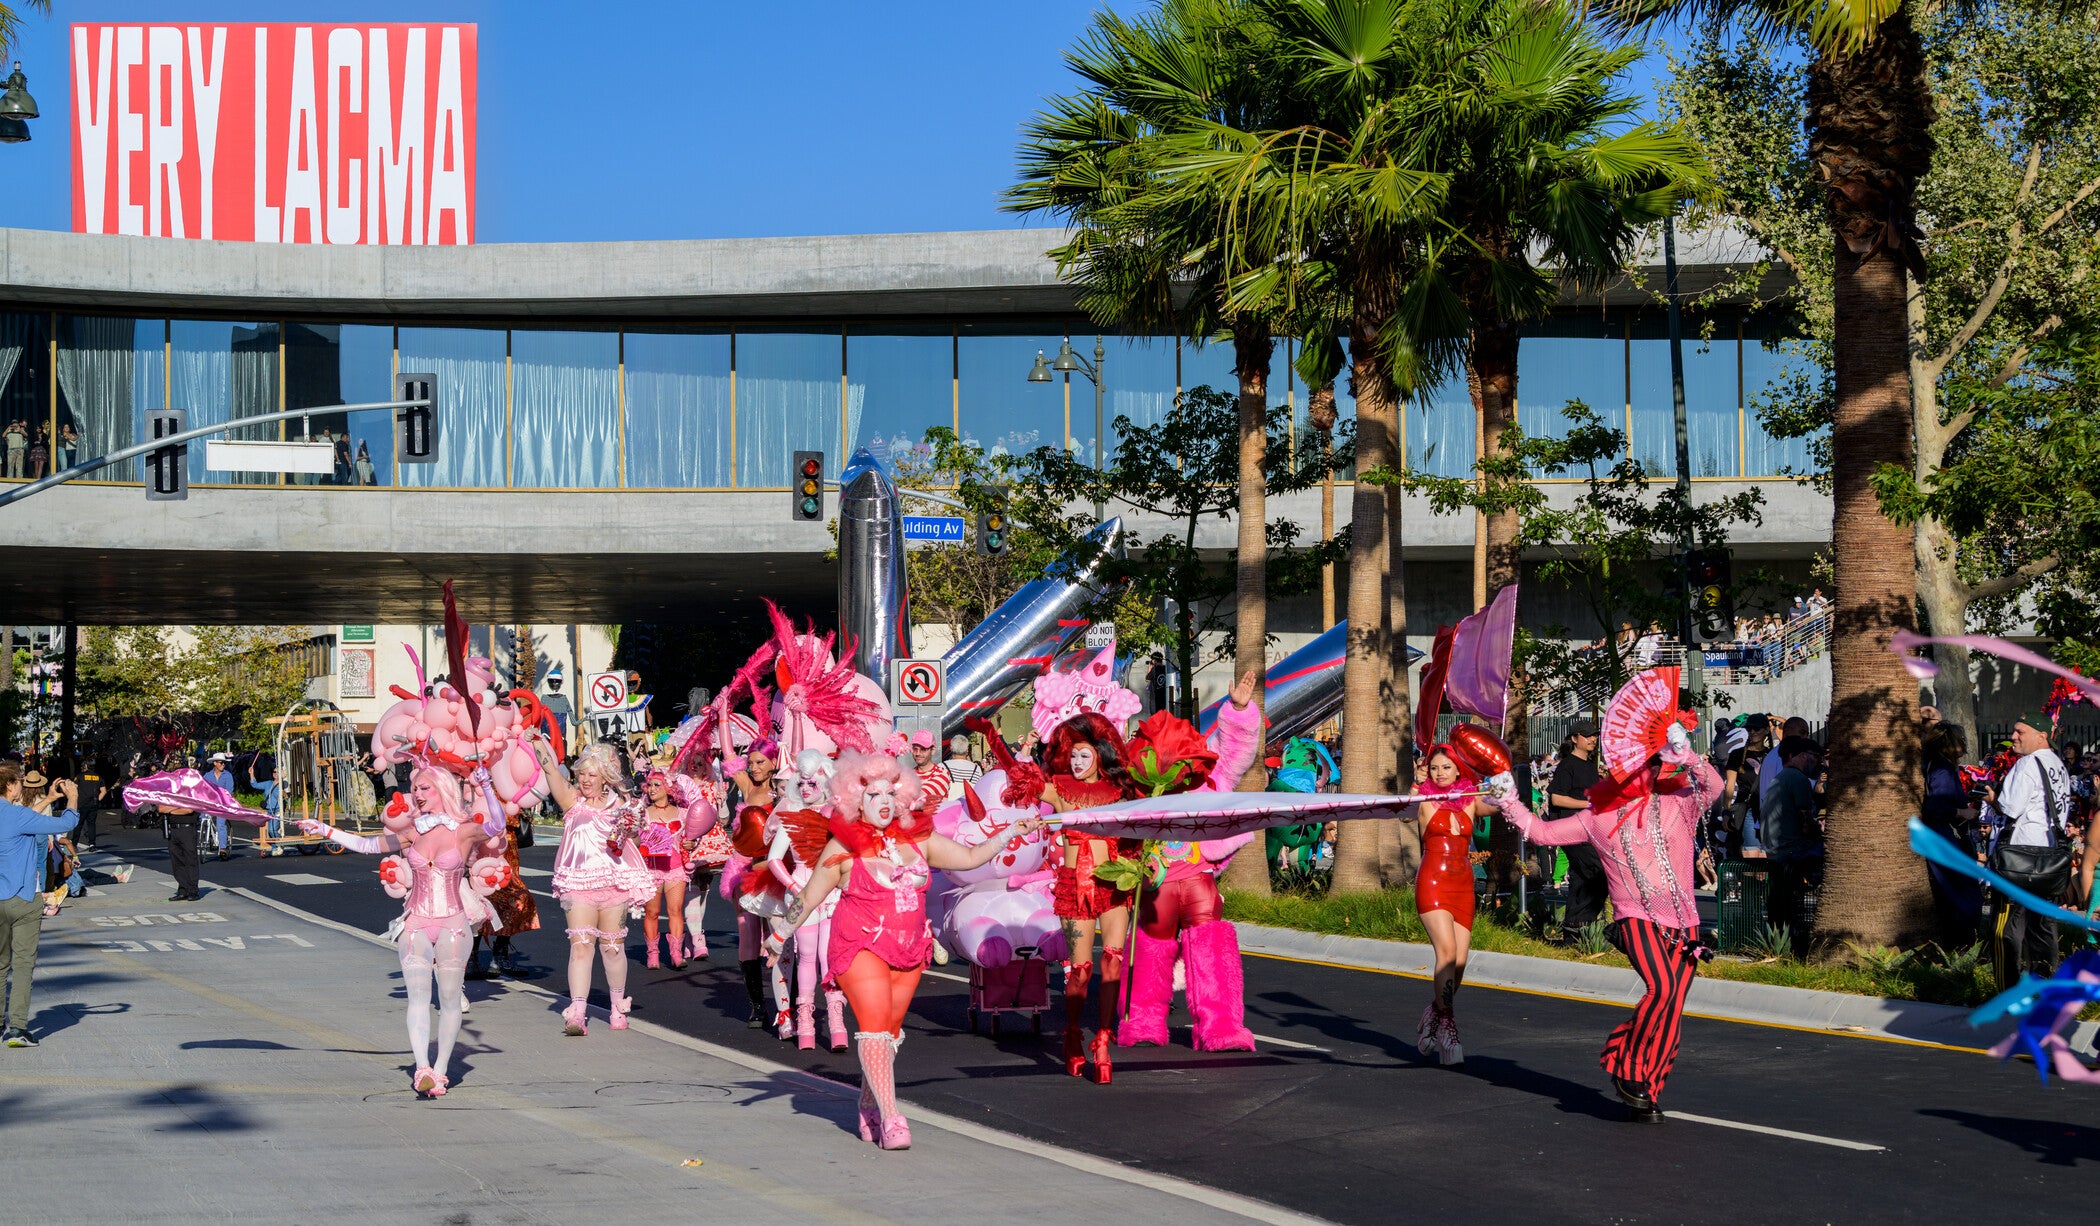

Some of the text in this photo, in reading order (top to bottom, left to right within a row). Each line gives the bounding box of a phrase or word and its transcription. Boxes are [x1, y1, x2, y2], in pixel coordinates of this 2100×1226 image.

[73, 26, 469, 245] VERY LACMA
[943, 522, 959, 534] Av
[1100, 626, 1114, 635] NOT
[1705, 650, 1763, 662] Spaulding Av
[1608, 688, 1647, 739] CLOWN
[89, 912, 229, 927] BUS
[89, 933, 316, 953] LANE
